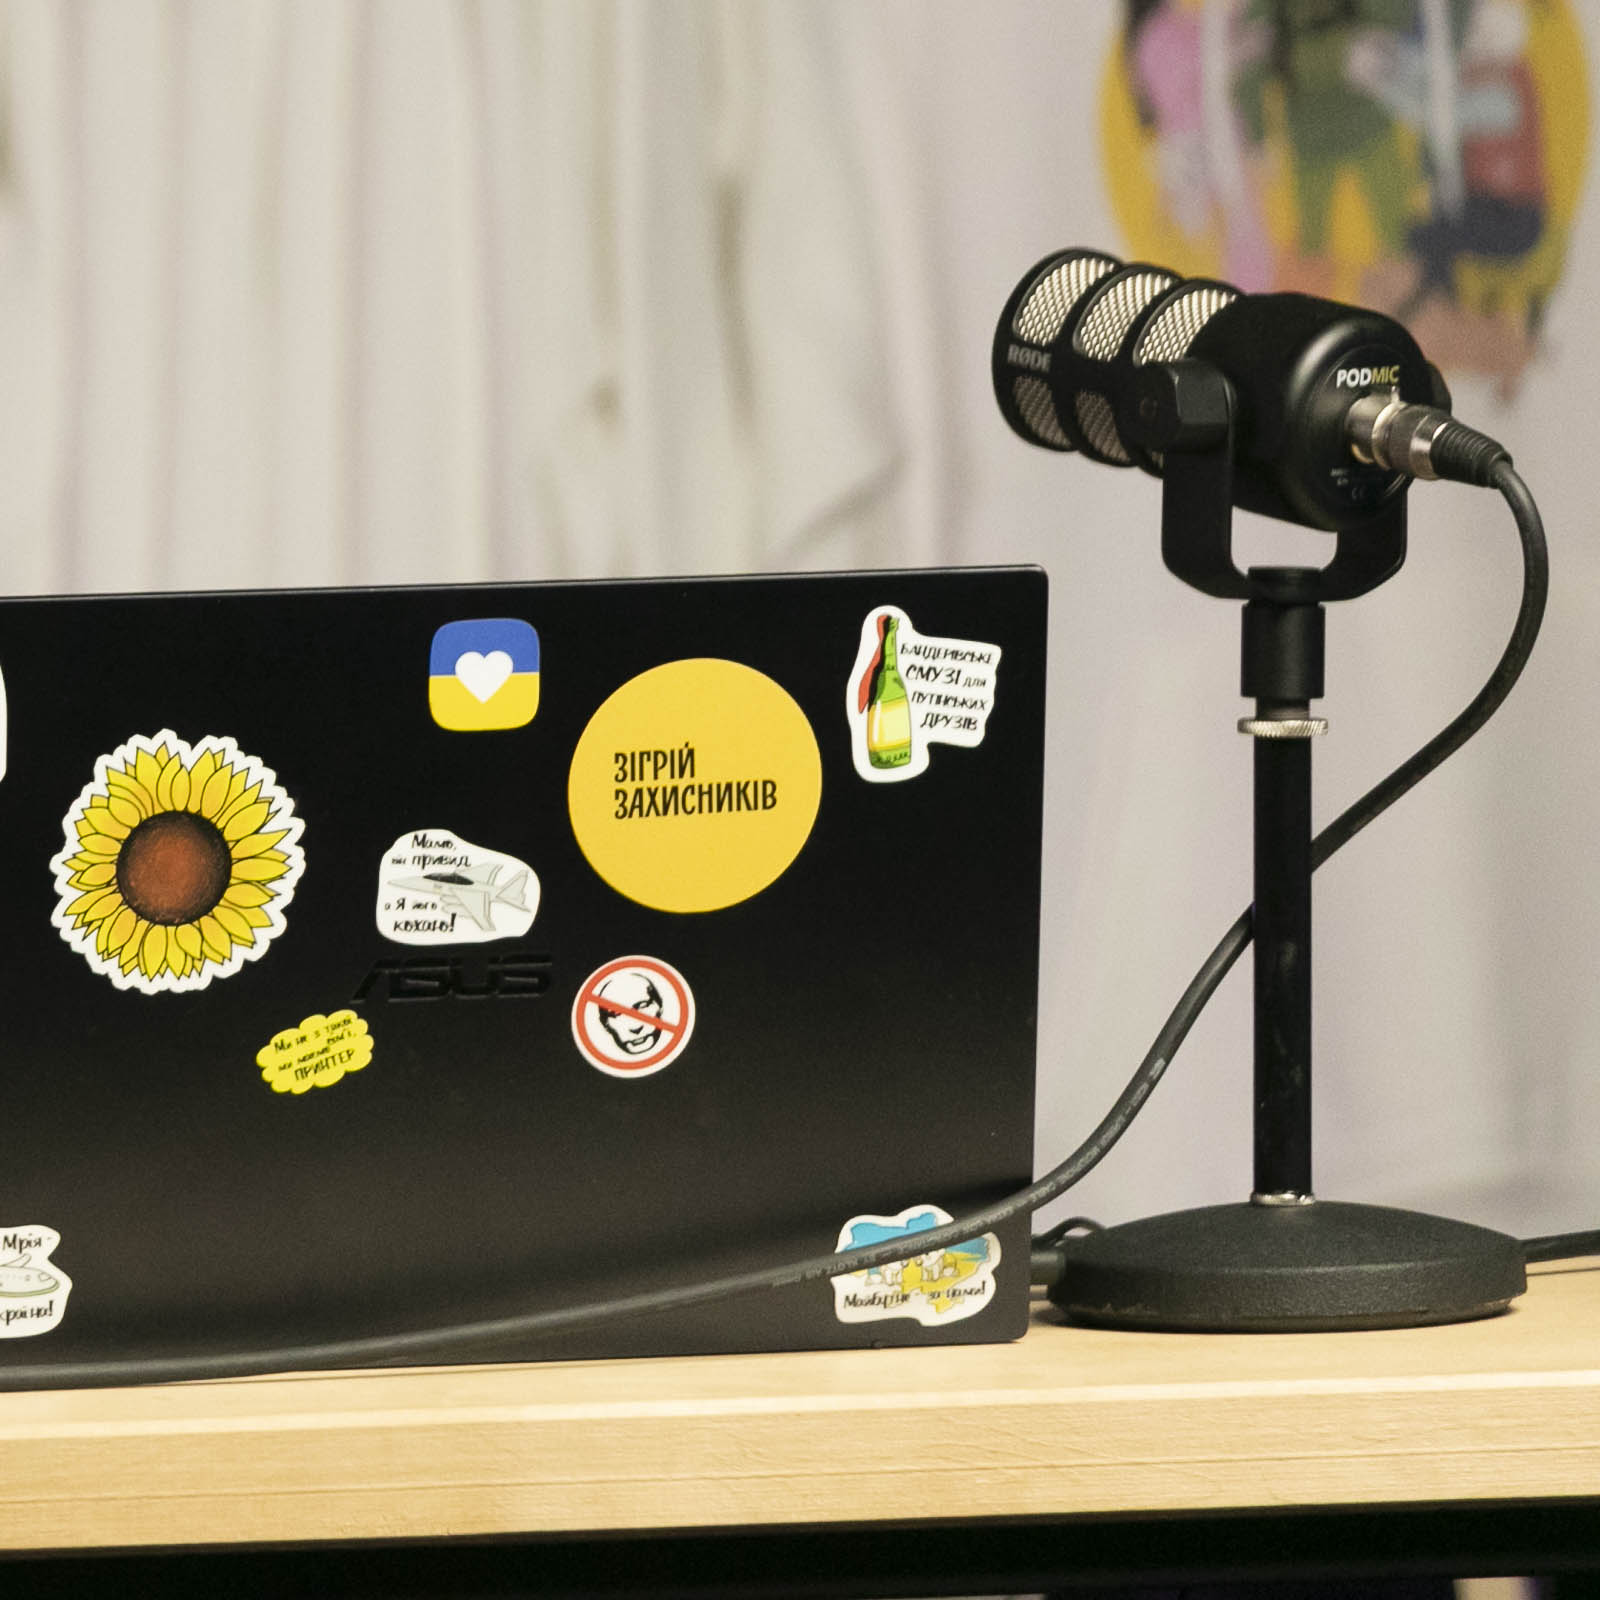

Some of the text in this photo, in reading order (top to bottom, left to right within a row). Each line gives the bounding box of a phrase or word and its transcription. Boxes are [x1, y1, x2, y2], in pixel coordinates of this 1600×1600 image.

[1335, 364, 1400, 389] PODMIC
[905, 664, 962, 685] СМУЗІ
[920, 712, 978, 730] ДРУЗІВ
[614, 741, 696, 783] ЗІГРІЙ
[614, 779, 778, 820] ЗАХИСНИКІВ
